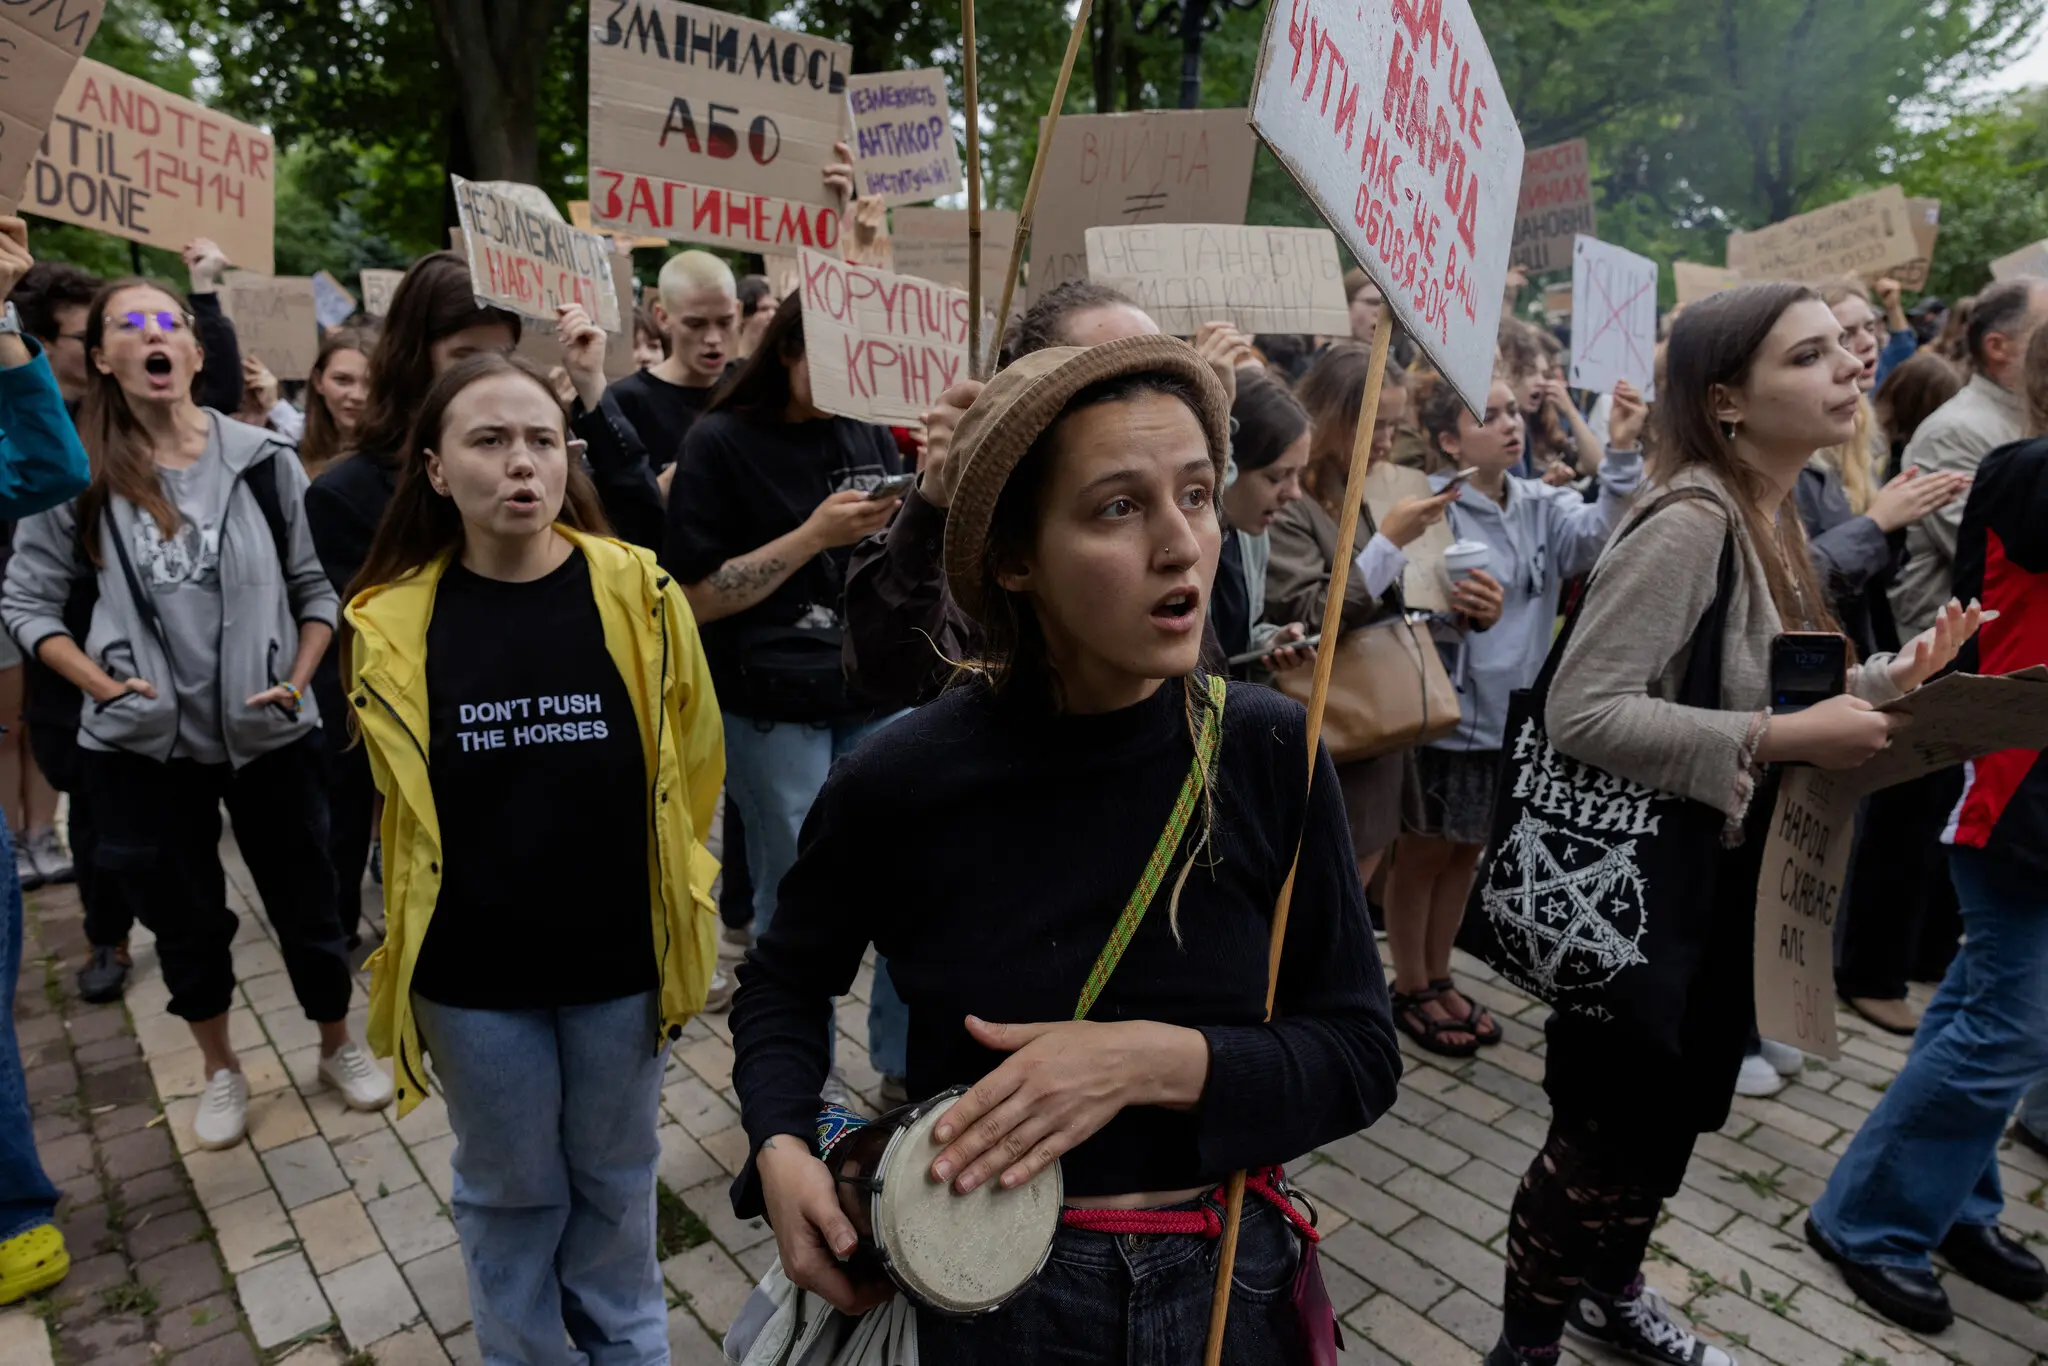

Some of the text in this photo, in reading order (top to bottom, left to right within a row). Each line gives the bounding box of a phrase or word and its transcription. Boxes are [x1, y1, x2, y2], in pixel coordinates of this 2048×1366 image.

[592, 0, 847, 95] ЗМІНИМОСЬ
[77, 76, 270, 182] AND TEAR
[659, 96, 781, 166] АБО
[857, 115, 943, 159] АНТИКОР
[1079, 118, 1211, 193] ВІЙНА
[1288, 0, 1360, 152] ЧУТИ
[1360, 111, 1403, 207] НАС
[1443, 241, 1478, 325] ВАШ
[35, 159, 151, 234] DONE
[132, 148, 245, 219] 12414
[593, 168, 840, 250] ЗАГИНЕМО
[486, 245, 544, 309] НАБУ
[1100, 229, 1163, 275] НЕ
[803, 251, 969, 345] КОРУПЦІЯ
[457, 720, 609, 752] THE HORSES
[459, 693, 602, 724] DON'T PUSH
[1511, 763, 1663, 837] METAL
[1779, 797, 1830, 869] НАРОД
[1780, 857, 1837, 927] СХАВАЄ
[1779, 923, 1805, 967] АЛЕ
